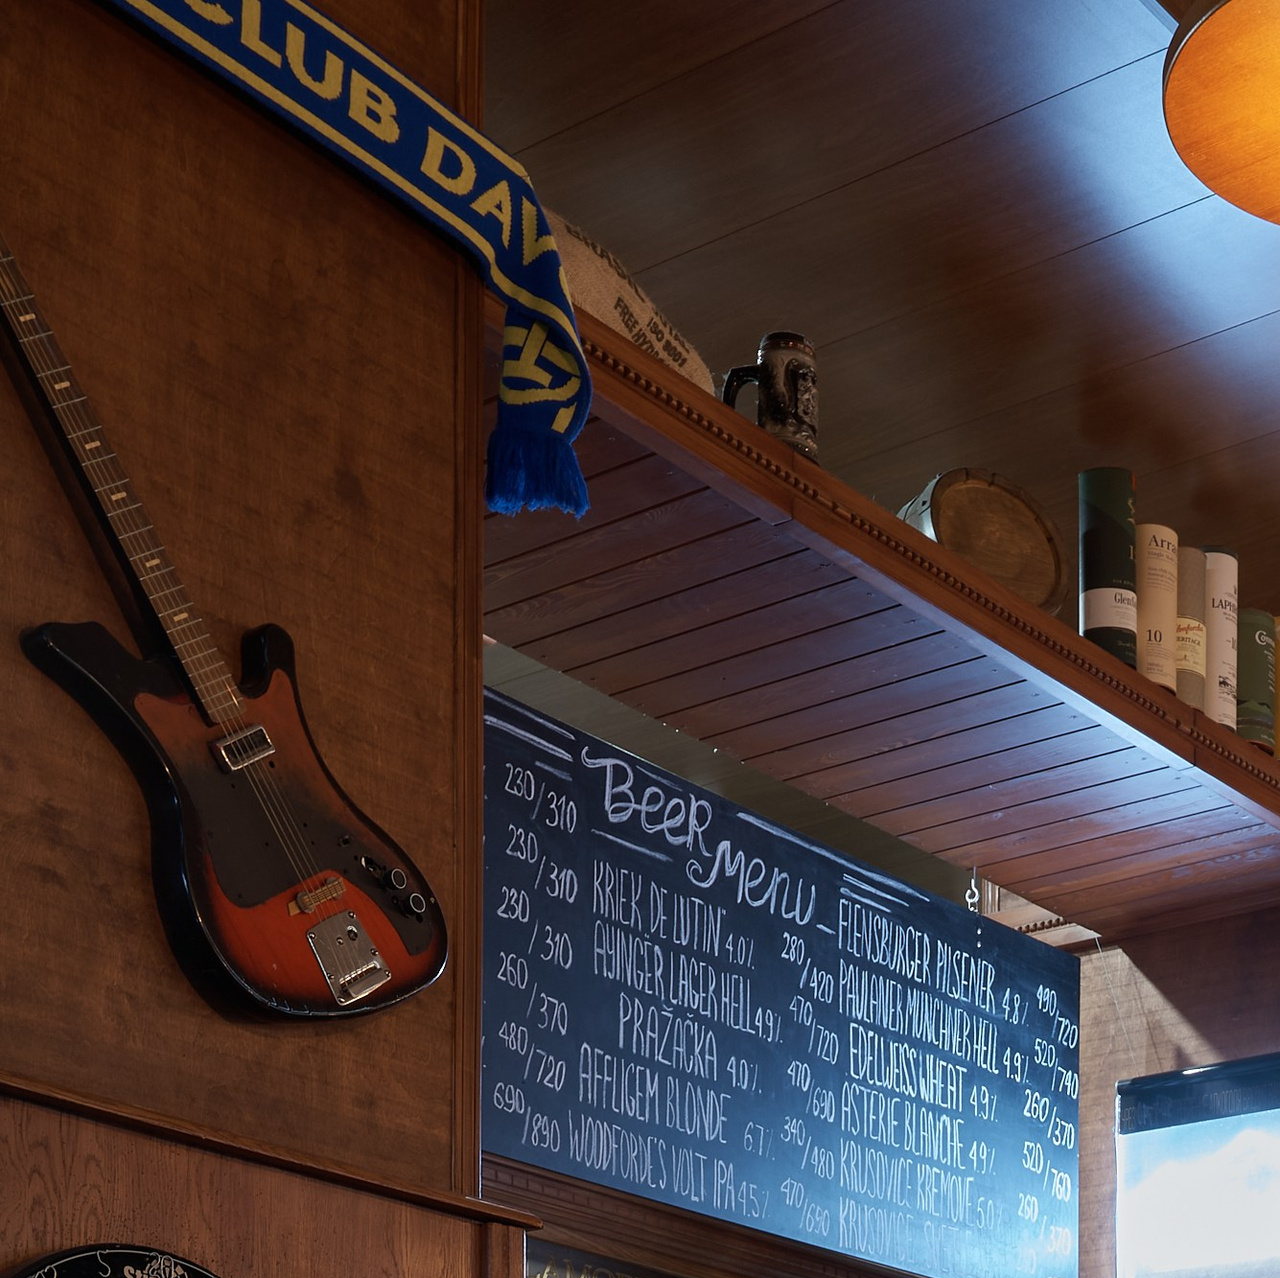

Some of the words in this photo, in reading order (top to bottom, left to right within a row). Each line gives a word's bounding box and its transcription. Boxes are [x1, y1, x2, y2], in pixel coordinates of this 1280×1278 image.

[613, 296, 641, 335] FREE
[1146, 629, 1163, 643] 10
[593, 858, 643, 932] KRIEK
[669, 951, 719, 1024] LAGER
[838, 897, 932, 986] FLENSBURGER
[935, 938, 997, 1016] PILSENER
[838, 956, 905, 1036] PAULANER
[971, 1015, 1000, 1076] HELL
[579, 1042, 660, 1126] AFFLIGEM
[665, 1075, 732, 1145] BLONDE
[849, 1022, 919, 1100] EDELWEISS
[917, 1049, 968, 1113] WHEAT
[840, 1080, 901, 1148] ASTERIE
[903, 1100, 966, 1171] BLANCHE
[671, 1144, 709, 1203] VOLT
[712, 1158, 736, 1214] IPA
[839, 1137, 914, 1211] KRUSOVICE
[915, 1162, 976, 1228] KREMOVE
